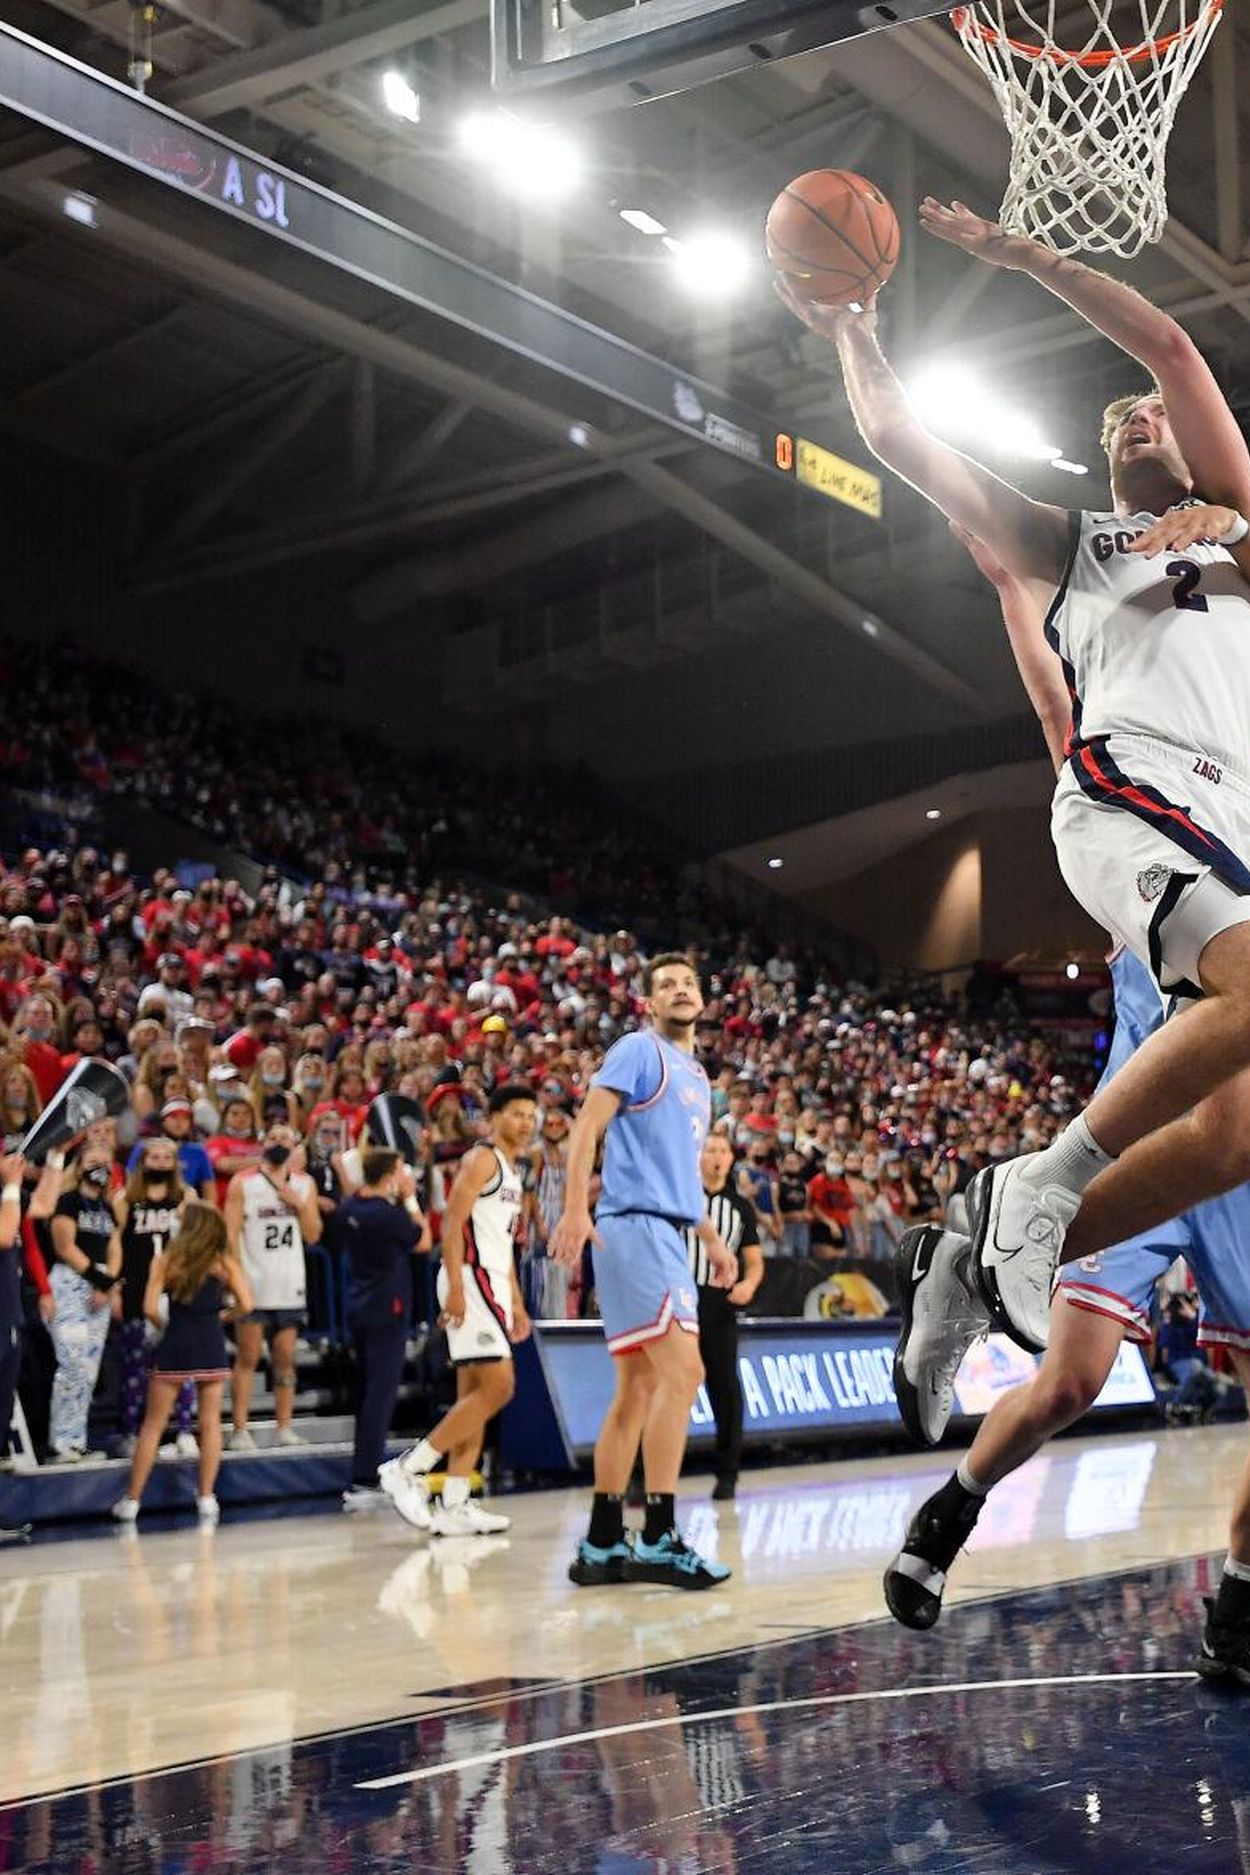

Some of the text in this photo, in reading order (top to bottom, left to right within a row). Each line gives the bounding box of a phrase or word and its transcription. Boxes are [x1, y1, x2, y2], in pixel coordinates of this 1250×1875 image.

[222, 156, 245, 206] A
[1166, 560, 1209, 612] 2
[1192, 757, 1223, 785] ZAGS
[264, 1225, 293, 1250] 24
[740, 1357, 769, 1418] A
[761, 1353, 831, 1414] PACK
